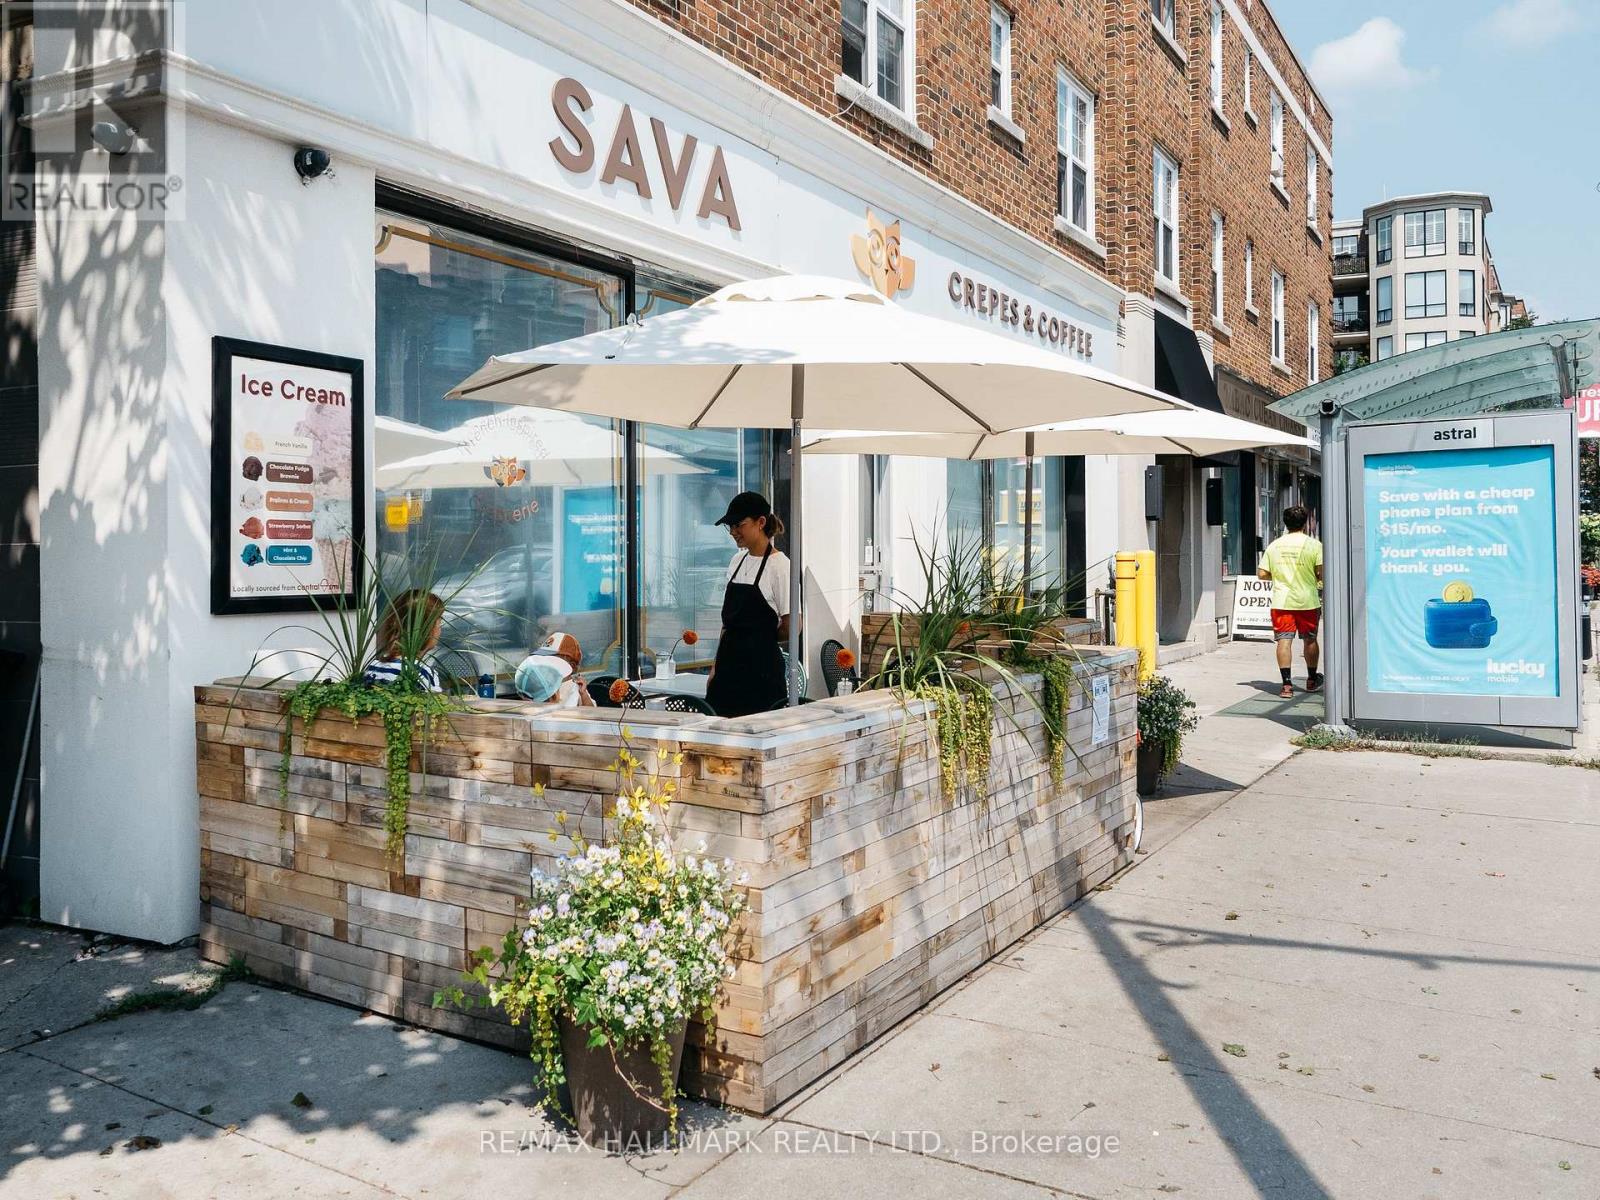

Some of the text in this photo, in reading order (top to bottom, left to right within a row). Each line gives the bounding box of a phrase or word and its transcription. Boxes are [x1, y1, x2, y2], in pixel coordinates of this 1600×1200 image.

[549, 77, 742, 231] SAVA
[948, 272, 1093, 357] CREPES & COFFEE
[241, 373, 346, 407] Ice Cream
[1433, 427, 1477, 441] astral
[1379, 487, 1535, 503] Save with a cheap
[1379, 503, 1519, 521] phone plan from
[1380, 522, 1446, 536] $15/mo.
[1380, 544, 1508, 558] Your wallet will
[1380, 561, 1471, 576] thank you.
[232, 585, 254, 593] Locally
[256, 583, 281, 592] sourced
[282, 583, 296, 591] from
[1243, 581, 1273, 592] NOW
[1486, 658, 1545, 678] lucky
[1487, 674, 1519, 684] mobile
